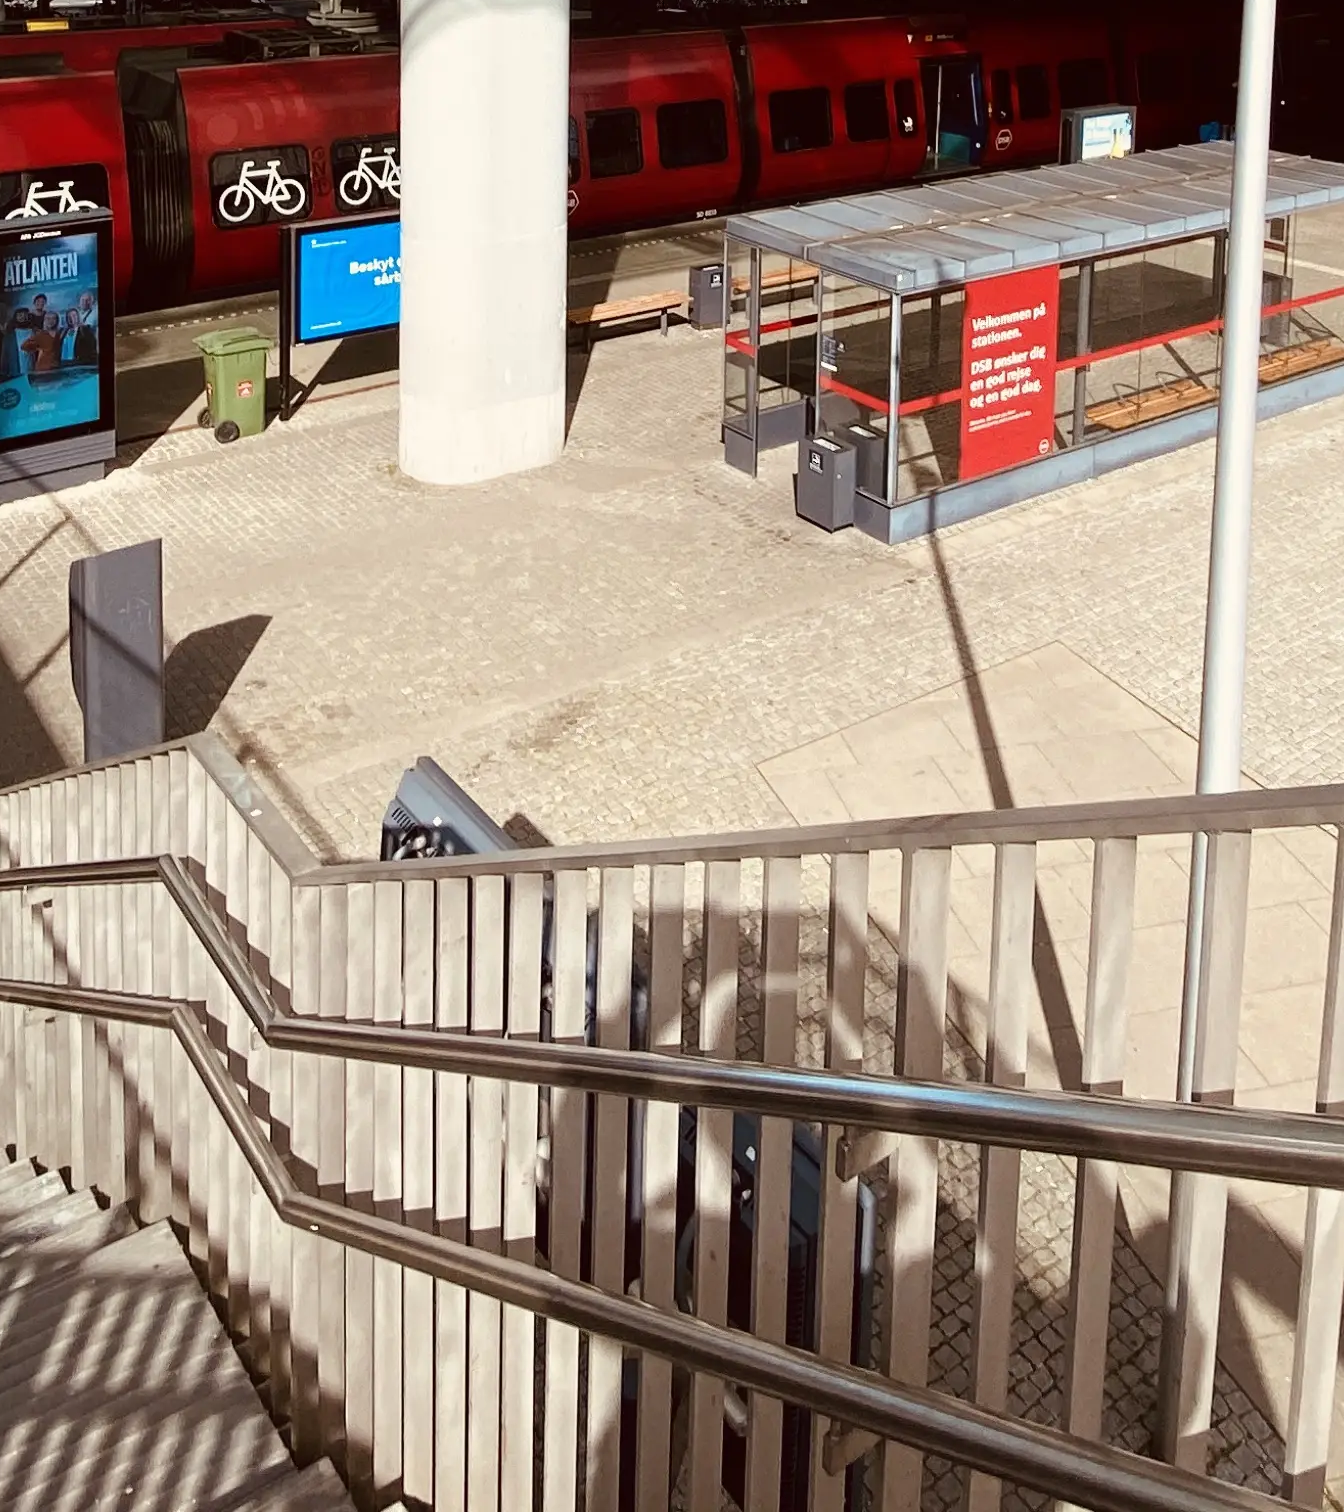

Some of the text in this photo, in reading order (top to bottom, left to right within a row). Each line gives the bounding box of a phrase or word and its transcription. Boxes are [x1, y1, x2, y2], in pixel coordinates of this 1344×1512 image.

[3, 251, 78, 287] ATLANTEN
[349, 256, 394, 275] Beskyt
[971, 302, 1046, 331] Velkommen på
[971, 328, 1022, 349] stationen.
[970, 345, 1047, 376] DSB ønsker dig
[969, 366, 1032, 393] en god rejse
[969, 379, 1043, 408] og en god dag.
